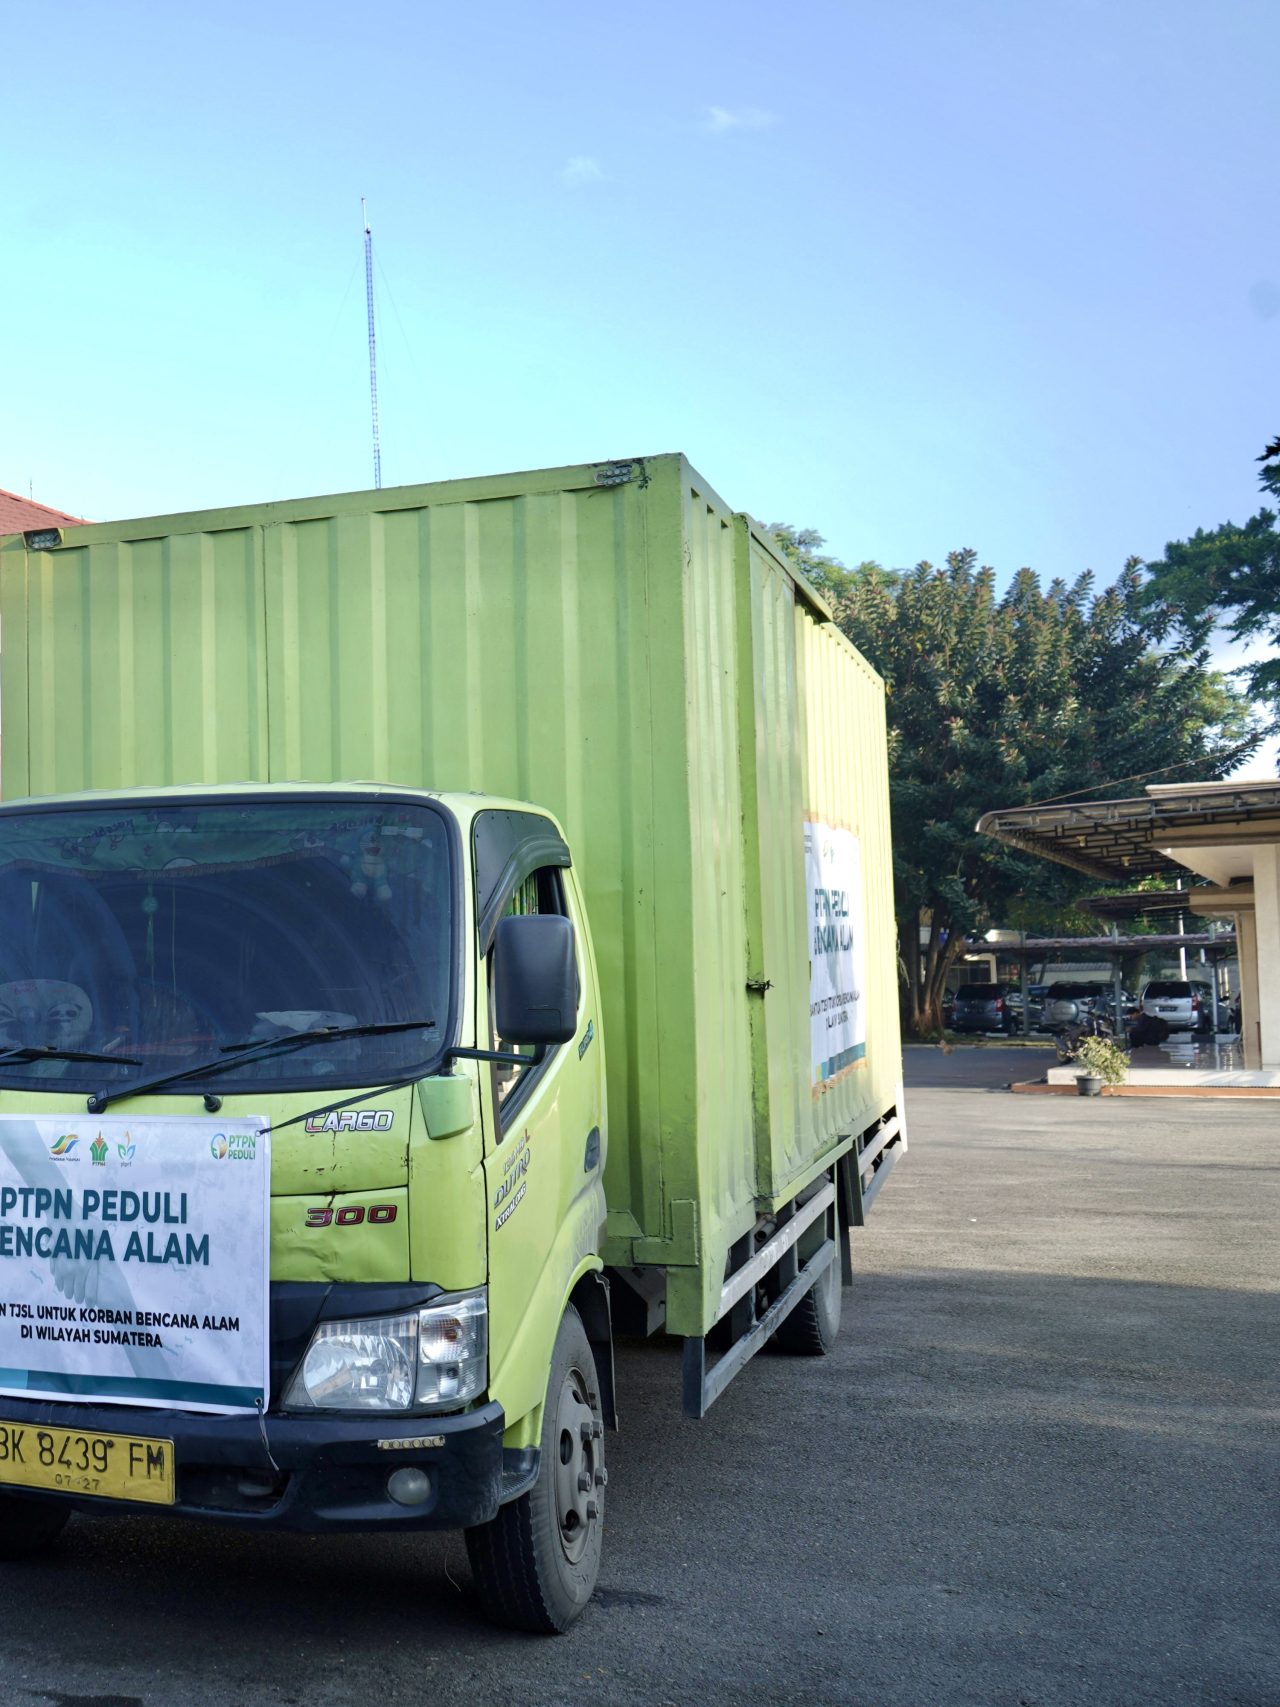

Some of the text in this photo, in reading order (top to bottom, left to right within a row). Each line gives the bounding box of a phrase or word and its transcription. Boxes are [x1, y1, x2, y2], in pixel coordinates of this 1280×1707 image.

[305, 1109, 394, 1133] CARGO
[228, 1135, 256, 1148] PTPN
[228, 1149, 256, 1160] PEDULI
[494, 1148, 531, 1210] DUTRO
[0, 1186, 188, 1225] PTPN PEDULI
[305, 1205, 398, 1228] 300
[122, 1230, 210, 1266] ALAM
[9, 1303, 34, 1319] TJSL
[36, 1305, 77, 1322] UNTUK
[79, 1308, 133, 1325] KORBAN
[135, 1311, 200, 1330] BENCANA
[201, 1315, 240, 1332] ALAM
[20, 1324, 163, 1348] DI WILAYAH SUMATERA
[38, 1432, 109, 1473] 8439
[129, 1442, 166, 1481] FM
